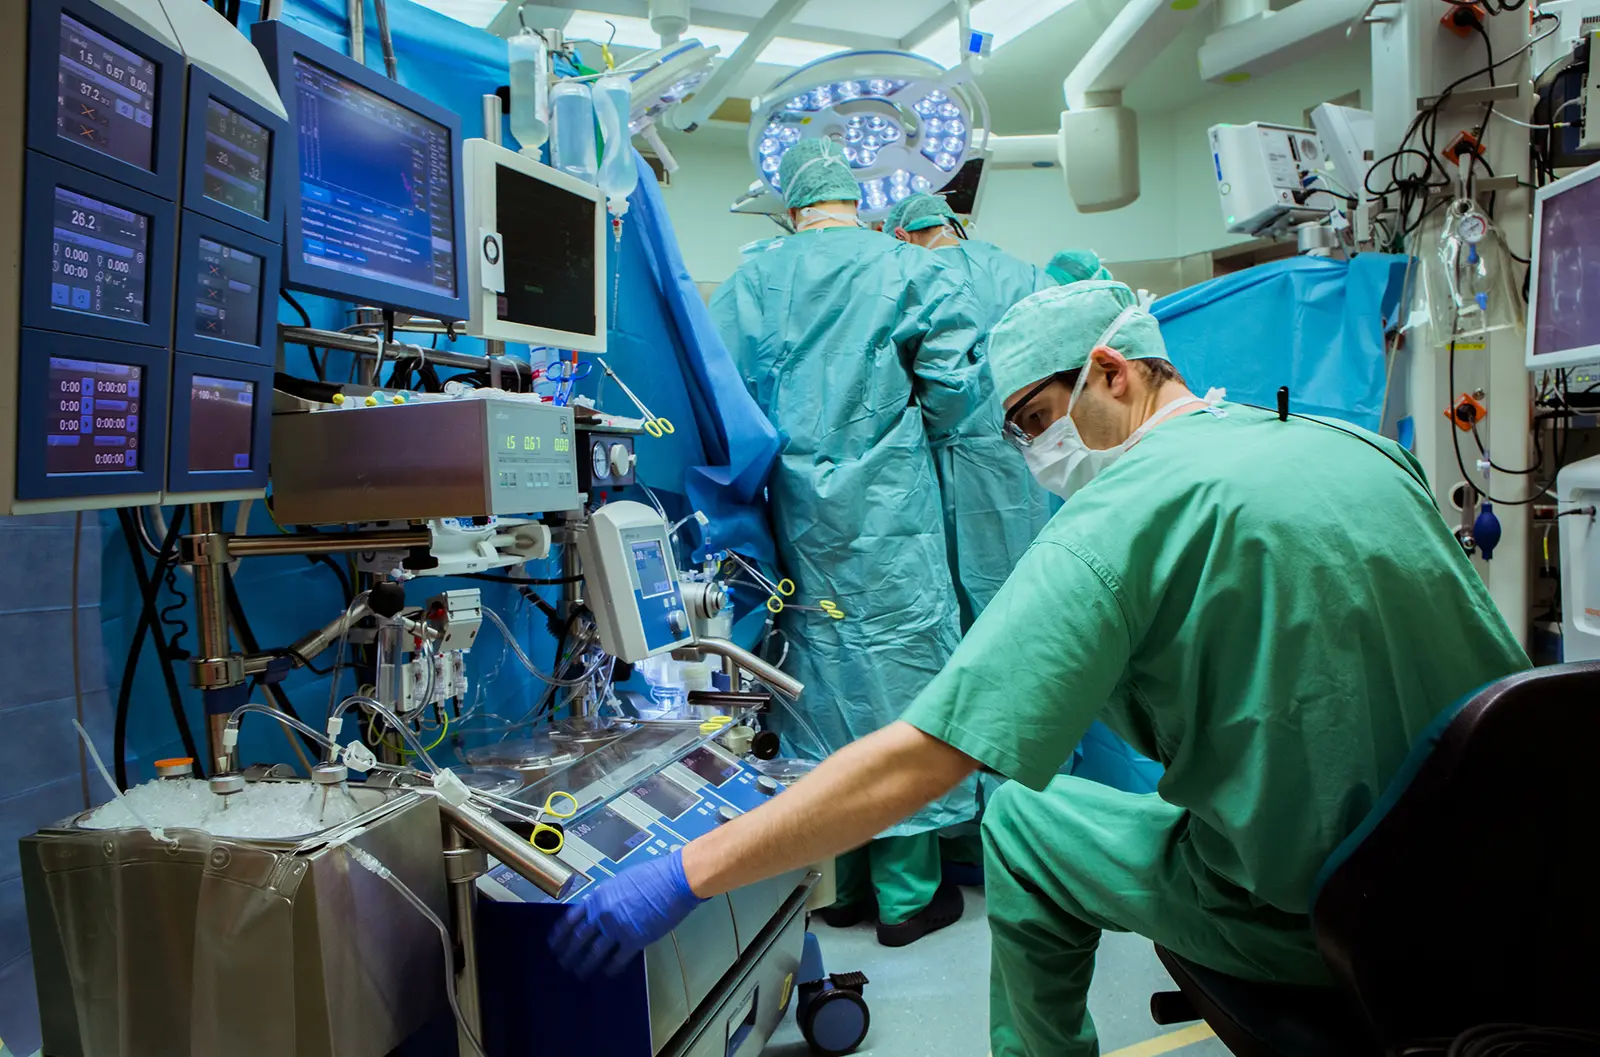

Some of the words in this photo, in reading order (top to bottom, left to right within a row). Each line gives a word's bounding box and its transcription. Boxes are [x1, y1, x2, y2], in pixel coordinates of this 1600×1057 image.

[79, 50, 93, 65] 1.5
[106, 63, 125, 80] 0.67
[80, 83, 100, 101] 37.2
[130, 76, 147, 93] 0.00
[71, 210, 96, 230] 26.2
[64, 247, 89, 263] 0.000
[63, 263, 88, 279] 00:00
[107, 258, 129, 273] 0.000
[61, 381, 80, 393] 0:00
[97, 381, 127, 394] 0:00:00
[60, 400, 80, 412] 0:00
[60, 419, 79, 431] 0:00
[96, 418, 125, 429] 0:00:00
[95, 454, 124, 464] 0:00:00
[496, 871, 514, 884] 0.00
